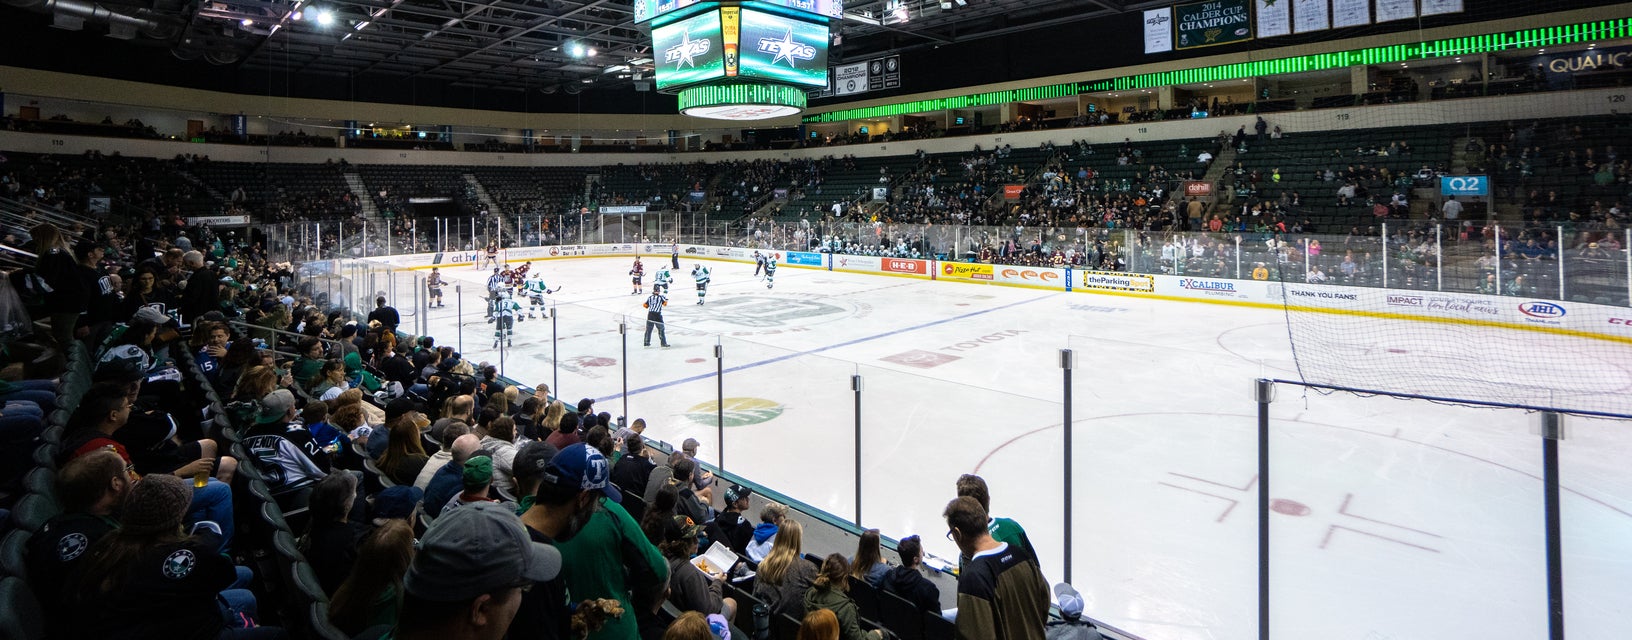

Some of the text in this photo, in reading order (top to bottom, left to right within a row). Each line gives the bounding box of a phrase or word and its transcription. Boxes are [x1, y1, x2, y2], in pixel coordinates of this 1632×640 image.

[1202, 2, 1222, 12] 2014
[1183, 9, 1221, 22] CALDER
[1223, 5, 1243, 16] CUP
[1180, 13, 1247, 31] CHAMPIONS
[665, 34, 711, 67] TEXAS
[758, 32, 816, 64] TEXAS
[1549, 53, 1632, 73] QUALIC
[1607, 94, 1626, 103] 120
[1449, 177, 1479, 191] Q2
[452, 254, 462, 262] at
[1054, 256, 1063, 264] 27
[1179, 278, 1234, 290] EXCALIBUR
[1291, 290, 1315, 298] THANK
[1387, 295, 1424, 305] IMPACT
[1527, 304, 1557, 315] AHL
[939, 330, 1029, 351] TOYOTA
[200, 361, 213, 372] 15
[591, 459, 606, 480] T
